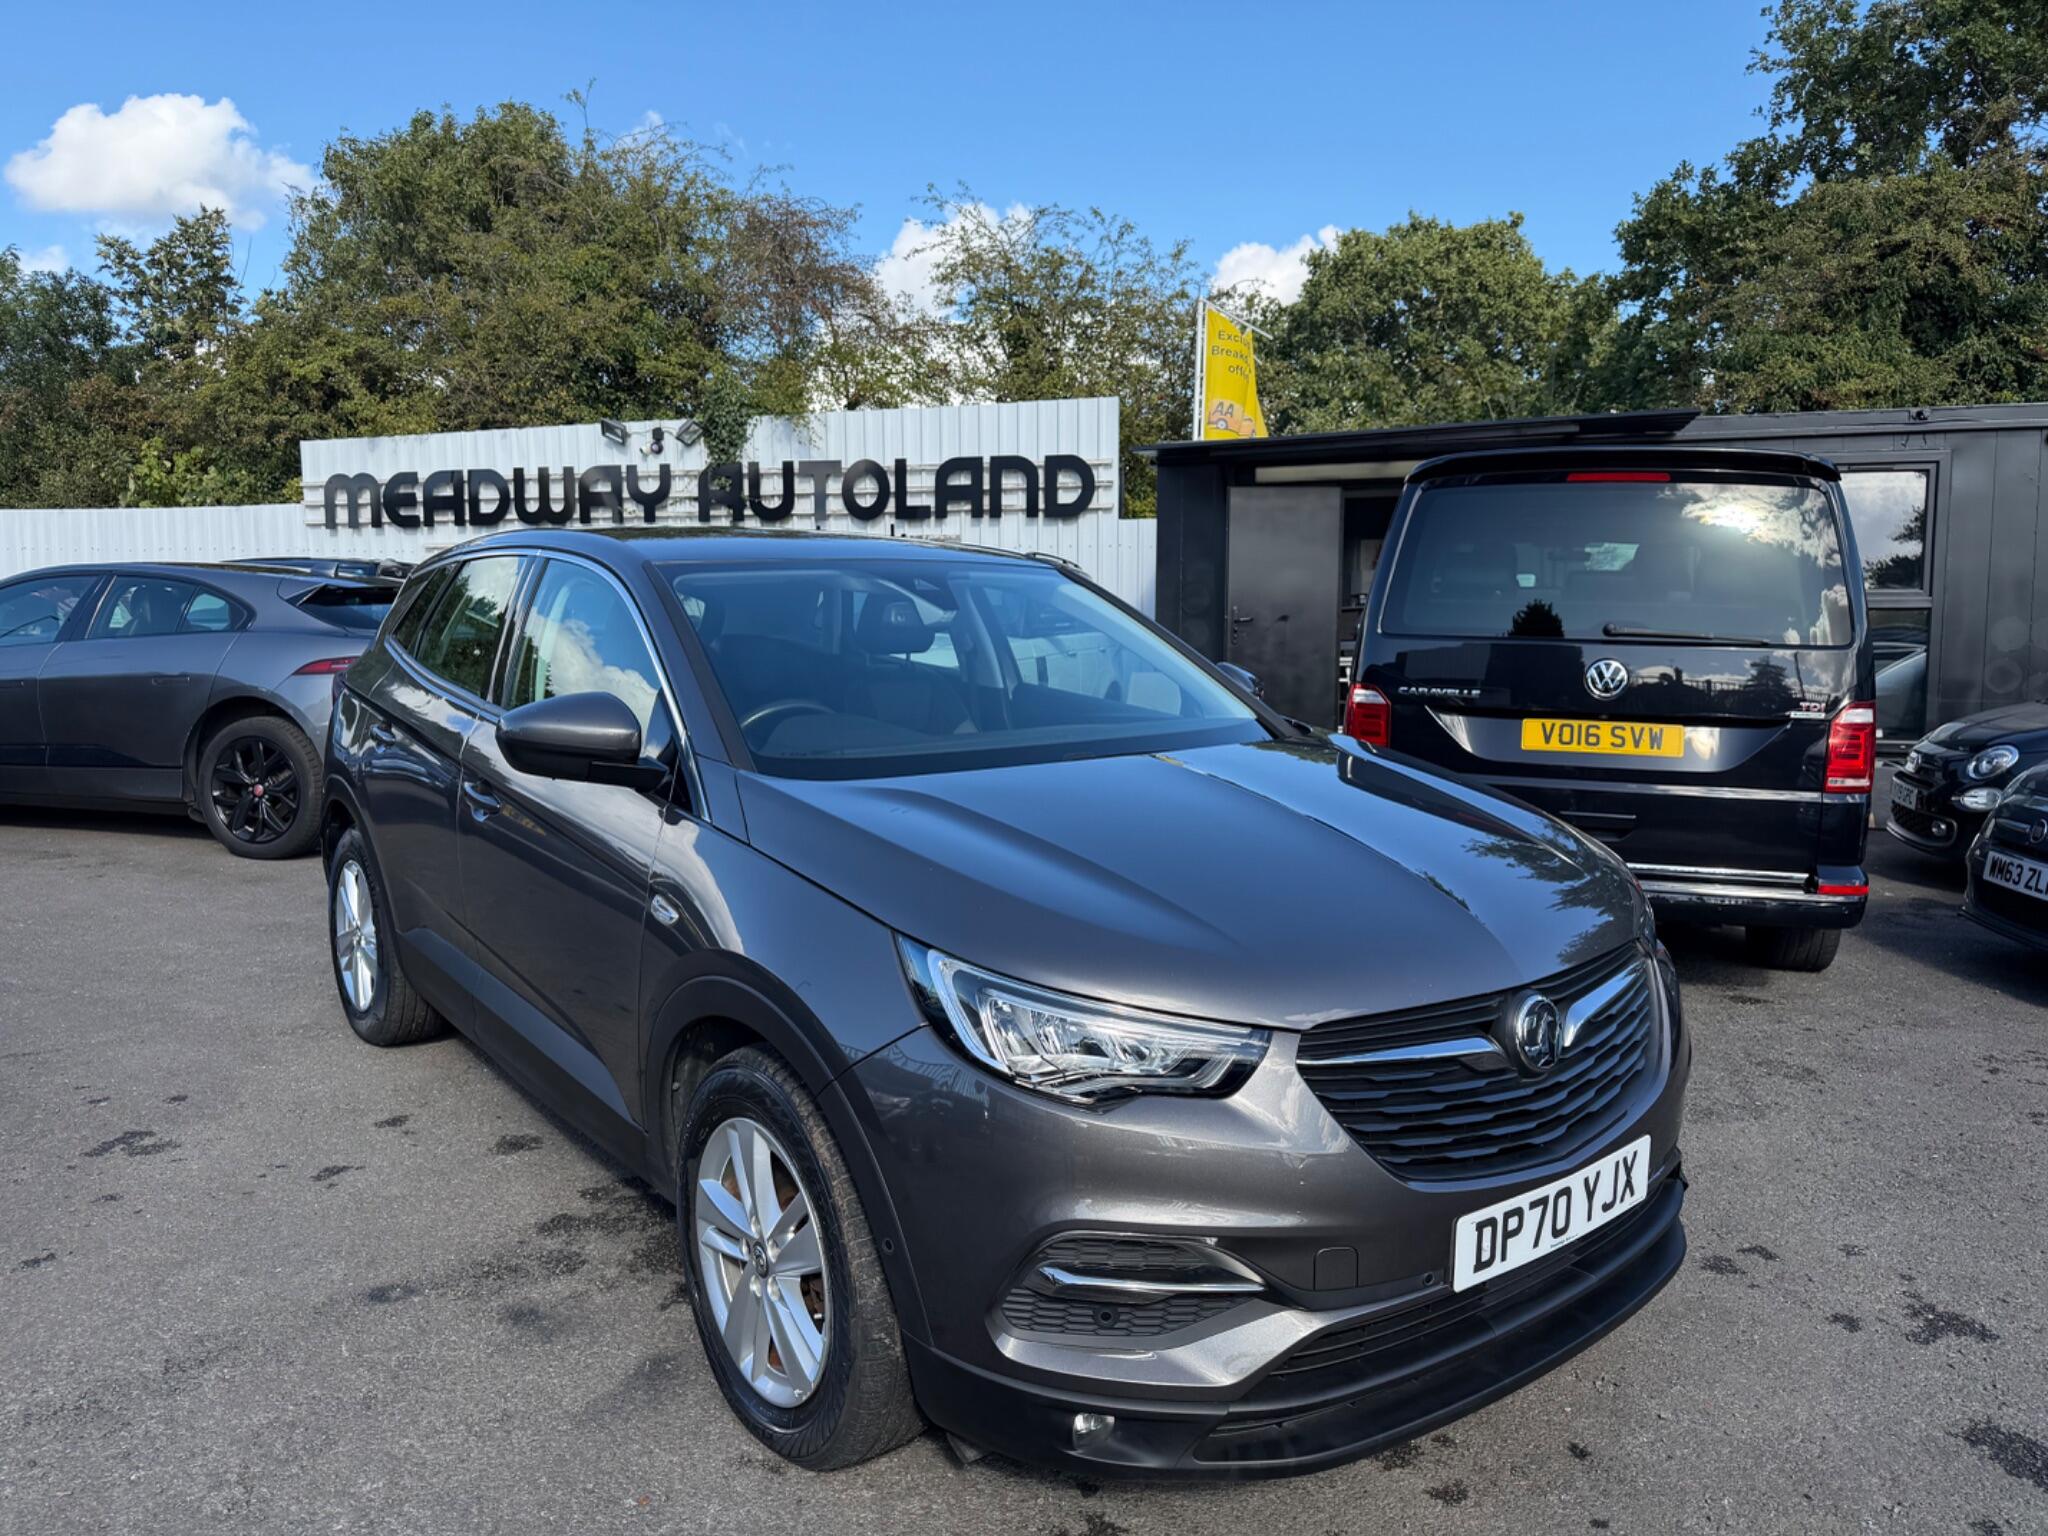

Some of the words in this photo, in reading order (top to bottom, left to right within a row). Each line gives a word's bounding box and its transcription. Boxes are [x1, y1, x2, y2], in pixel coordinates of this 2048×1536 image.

[1212, 401, 1234, 418] AA
[324, 463, 671, 529] MEADWAY
[698, 454, 1096, 522] AUTOLAND
[1799, 701, 1826, 713] TDI
[1541, 722, 1601, 747] VO16
[1610, 725, 1664, 751] SVW
[2024, 867, 2048, 896] ZL
[1473, 1186, 1572, 1274] DP70
[1584, 1150, 1638, 1223] YJX
